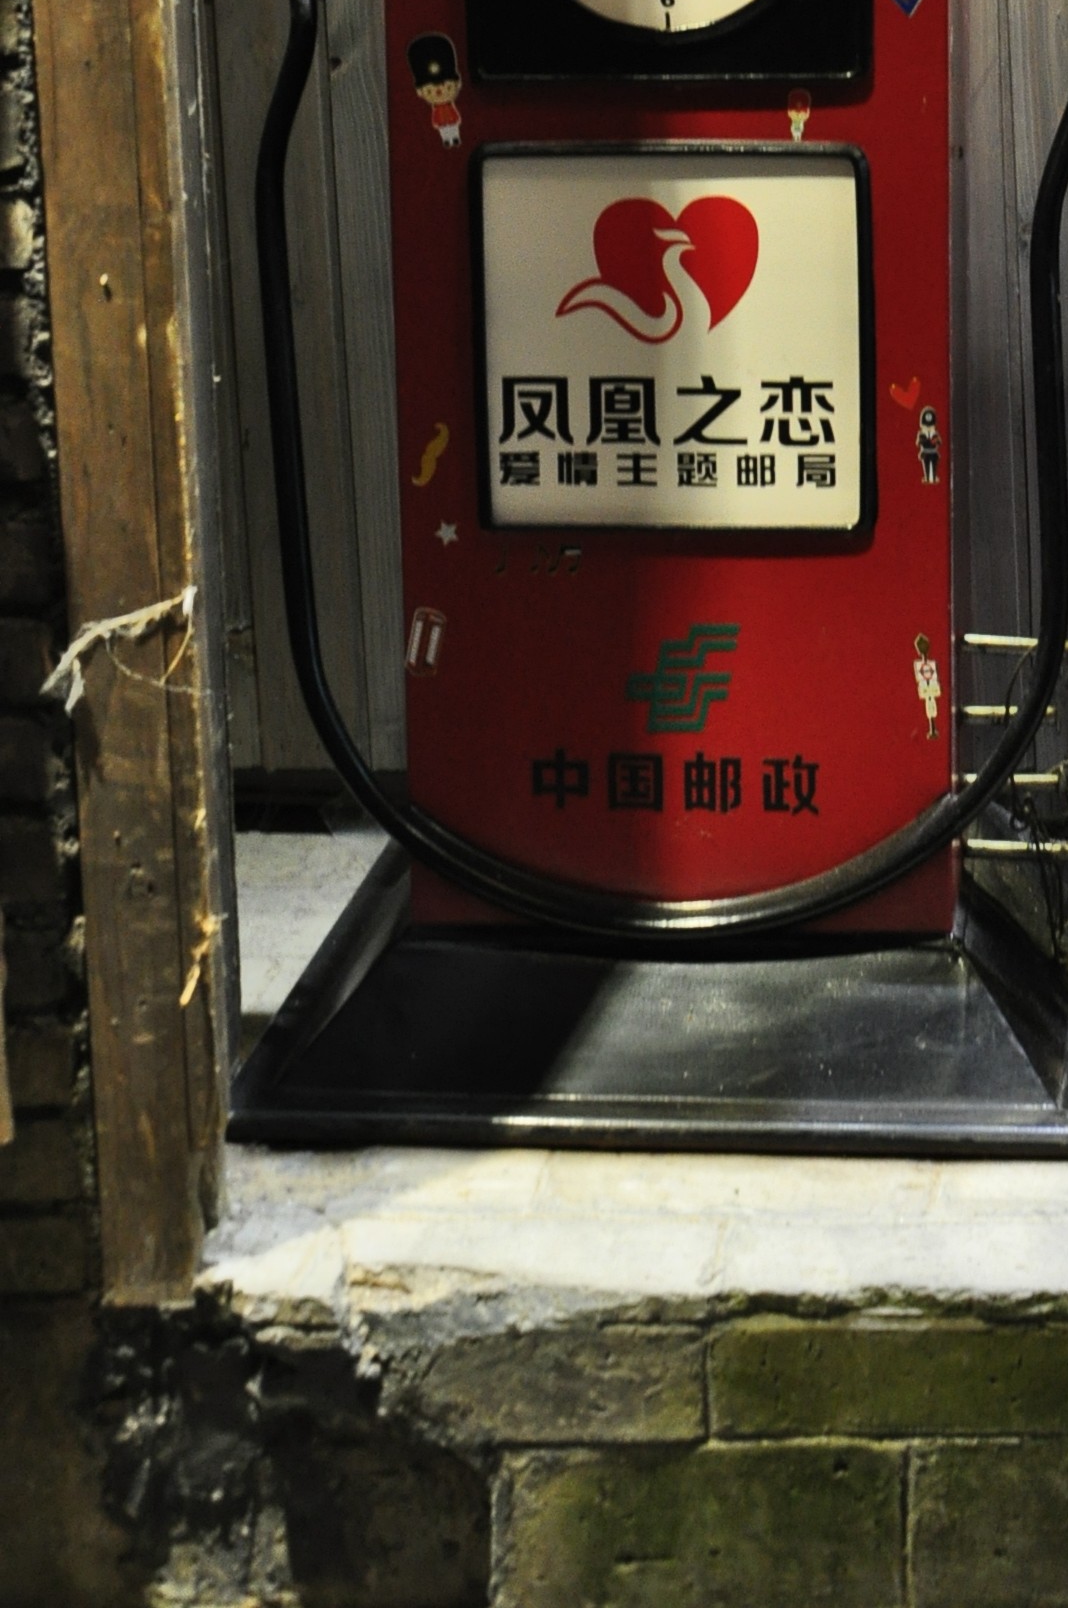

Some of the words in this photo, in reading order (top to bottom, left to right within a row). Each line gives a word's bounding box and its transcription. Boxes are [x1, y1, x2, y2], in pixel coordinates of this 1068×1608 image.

[499, 375, 836, 447] 凤凰之恋
[499, 451, 836, 488] 爱情主题邮局
[530, 748, 820, 816] 中国邮政
